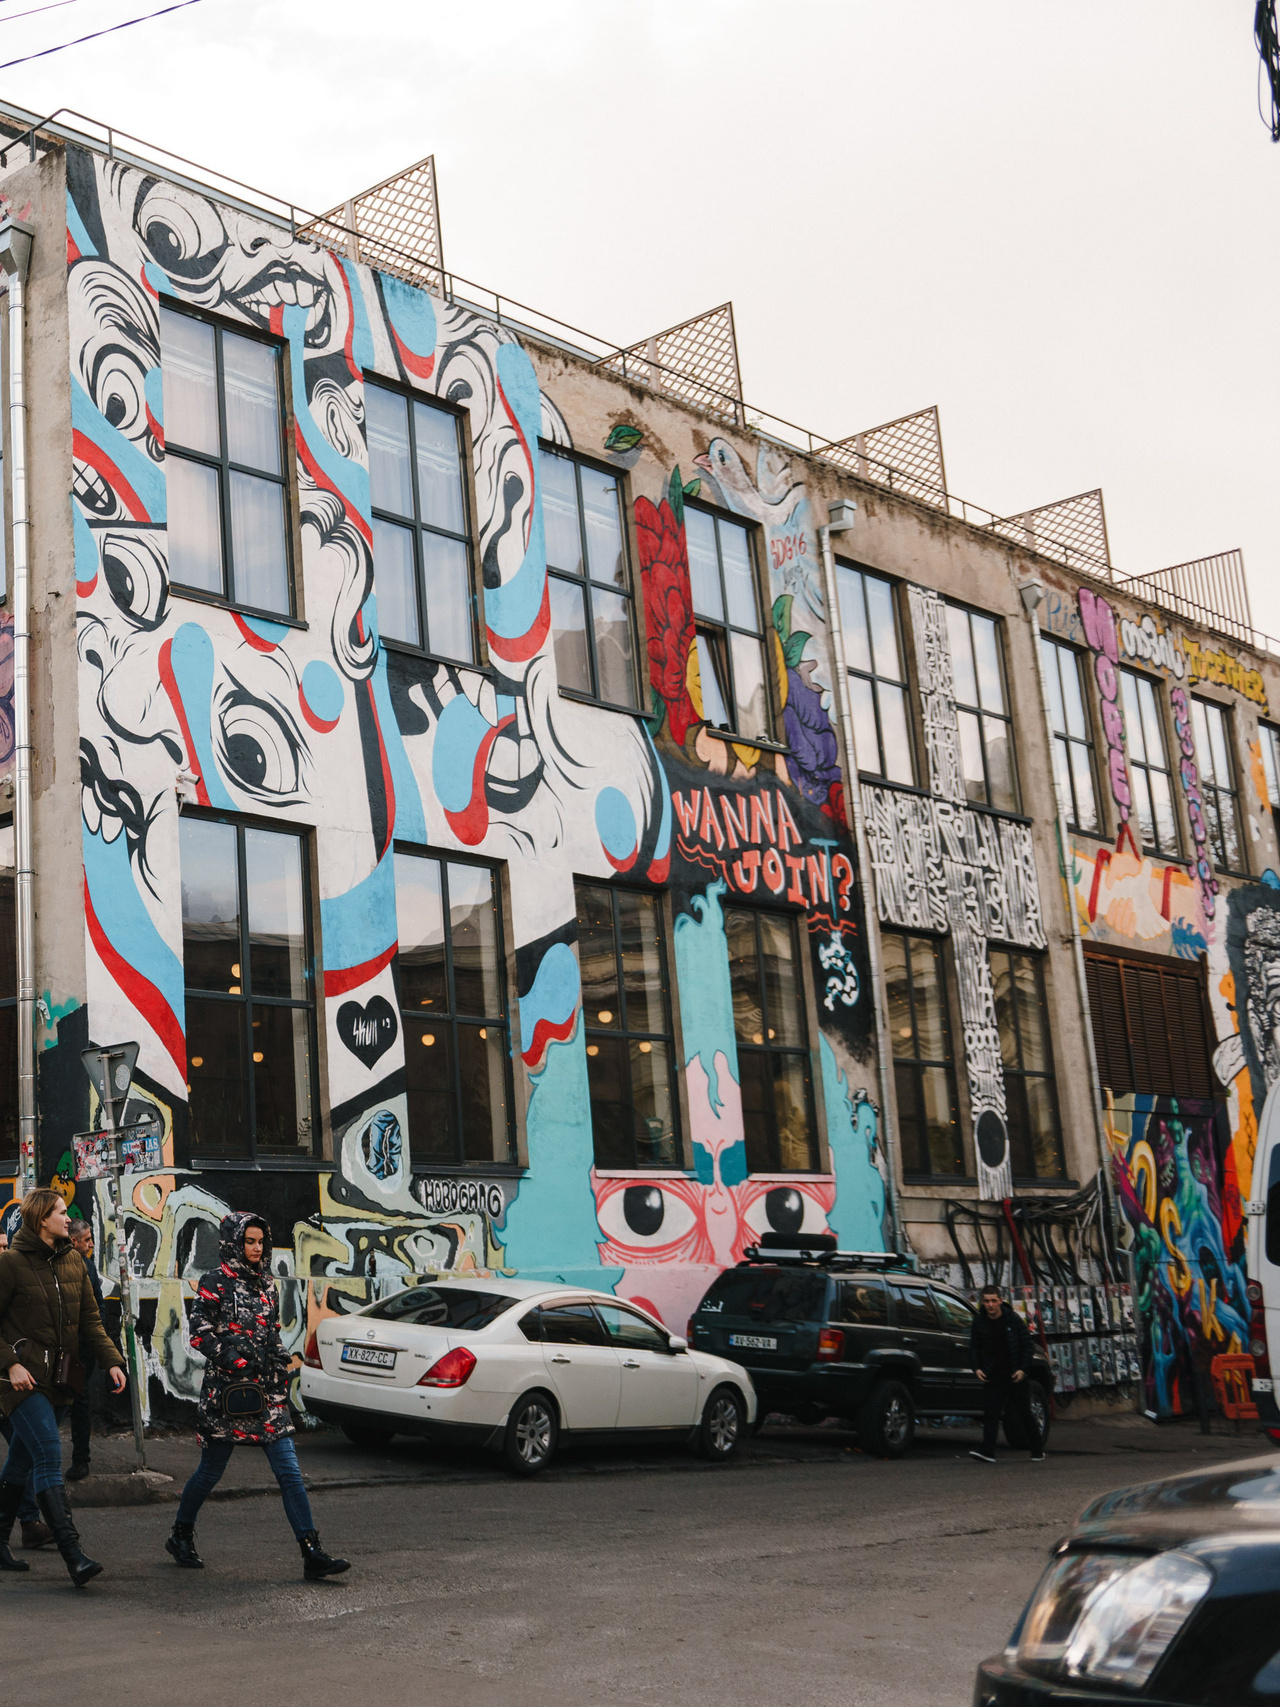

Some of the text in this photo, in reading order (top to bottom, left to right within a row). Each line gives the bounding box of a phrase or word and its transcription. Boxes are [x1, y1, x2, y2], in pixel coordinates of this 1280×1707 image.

[671, 786, 803, 853] WANNA
[421, 1179, 504, 1218] HOBOGANG
[347, 1346, 388, 1364] XX-827-CC
